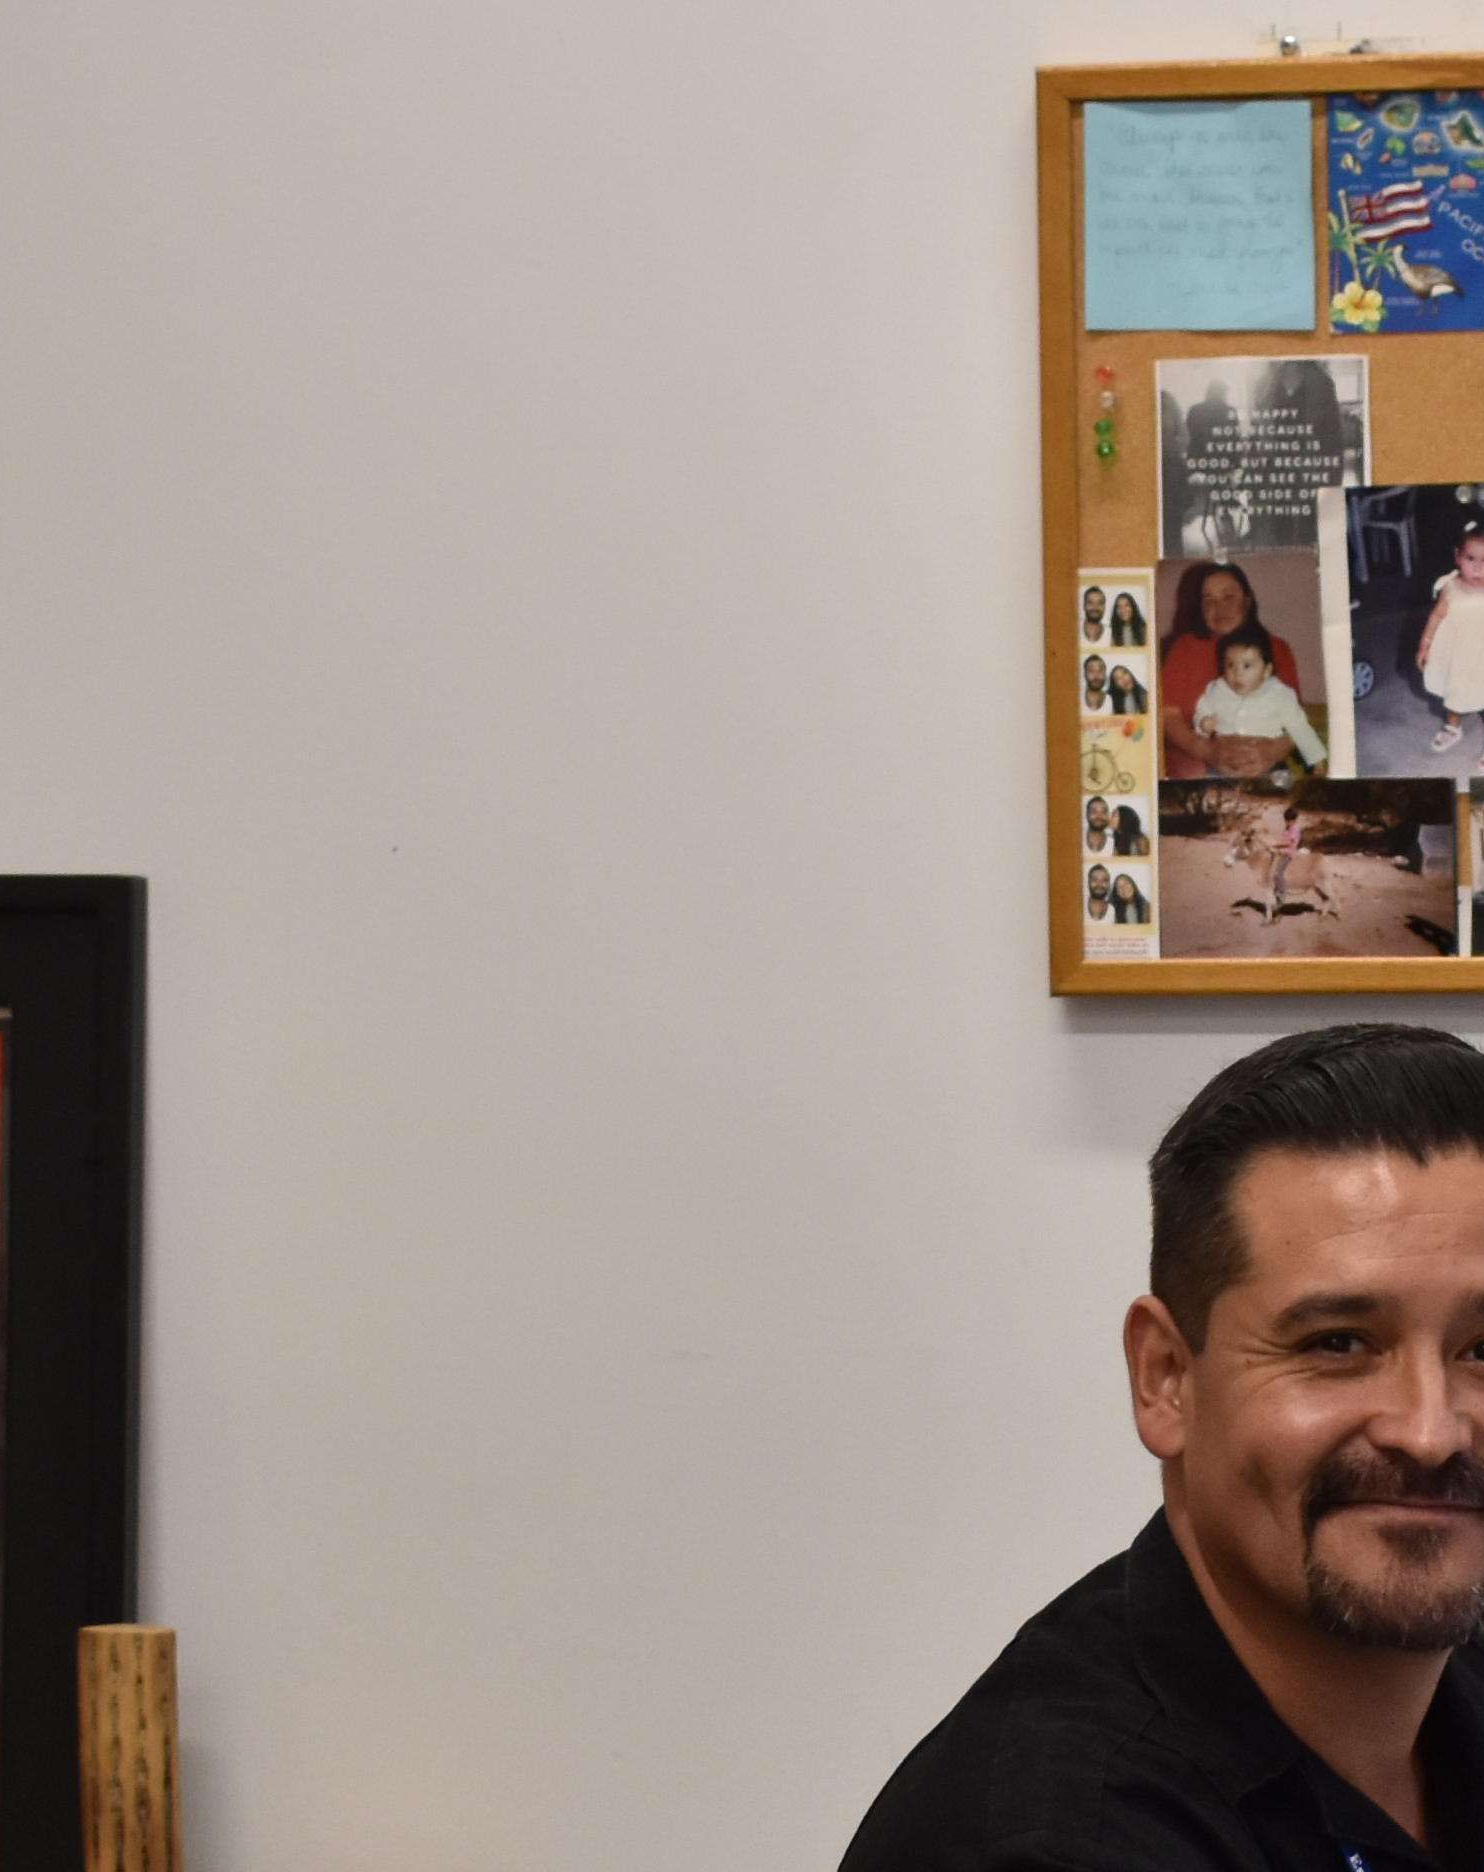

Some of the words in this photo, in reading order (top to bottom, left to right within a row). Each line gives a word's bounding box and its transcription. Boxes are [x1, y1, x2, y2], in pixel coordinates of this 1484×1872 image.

[1252, 408, 1299, 419] HAPPY
[1249, 424, 1314, 435] BECAUSE
[1207, 441, 1301, 452] EVERYTHING
[1307, 440, 1321, 451] IS
[1240, 458, 1268, 468] BUT
[1274, 456, 1341, 467] BECAUSE
[1198, 473, 1227, 484] YOU
[1234, 473, 1263, 483] CAN
[1269, 472, 1296, 483] SEE
[1303, 472, 1330, 482] THE
[1209, 490, 1253, 501] GOOD
[1259, 489, 1293, 499] SIDE
[1217, 505, 1312, 516] EVERYTHING
